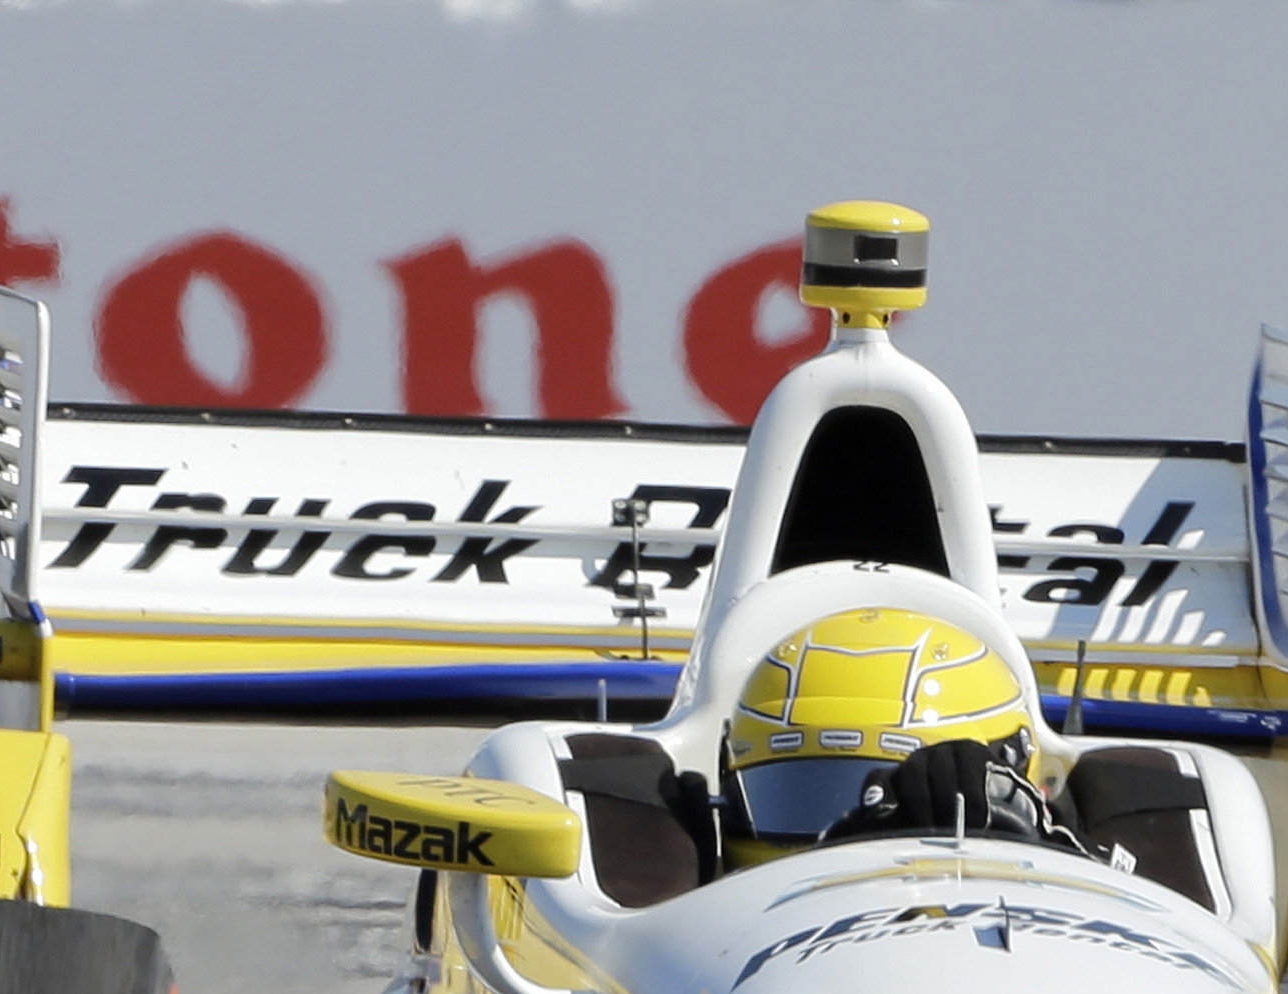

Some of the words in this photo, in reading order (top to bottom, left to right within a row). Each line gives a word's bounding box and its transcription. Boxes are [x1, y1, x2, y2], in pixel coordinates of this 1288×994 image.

[43, 465, 543, 586] Truck
[585, 484, 1196, 607] Ral
[335, 797, 495, 867] Mazak
